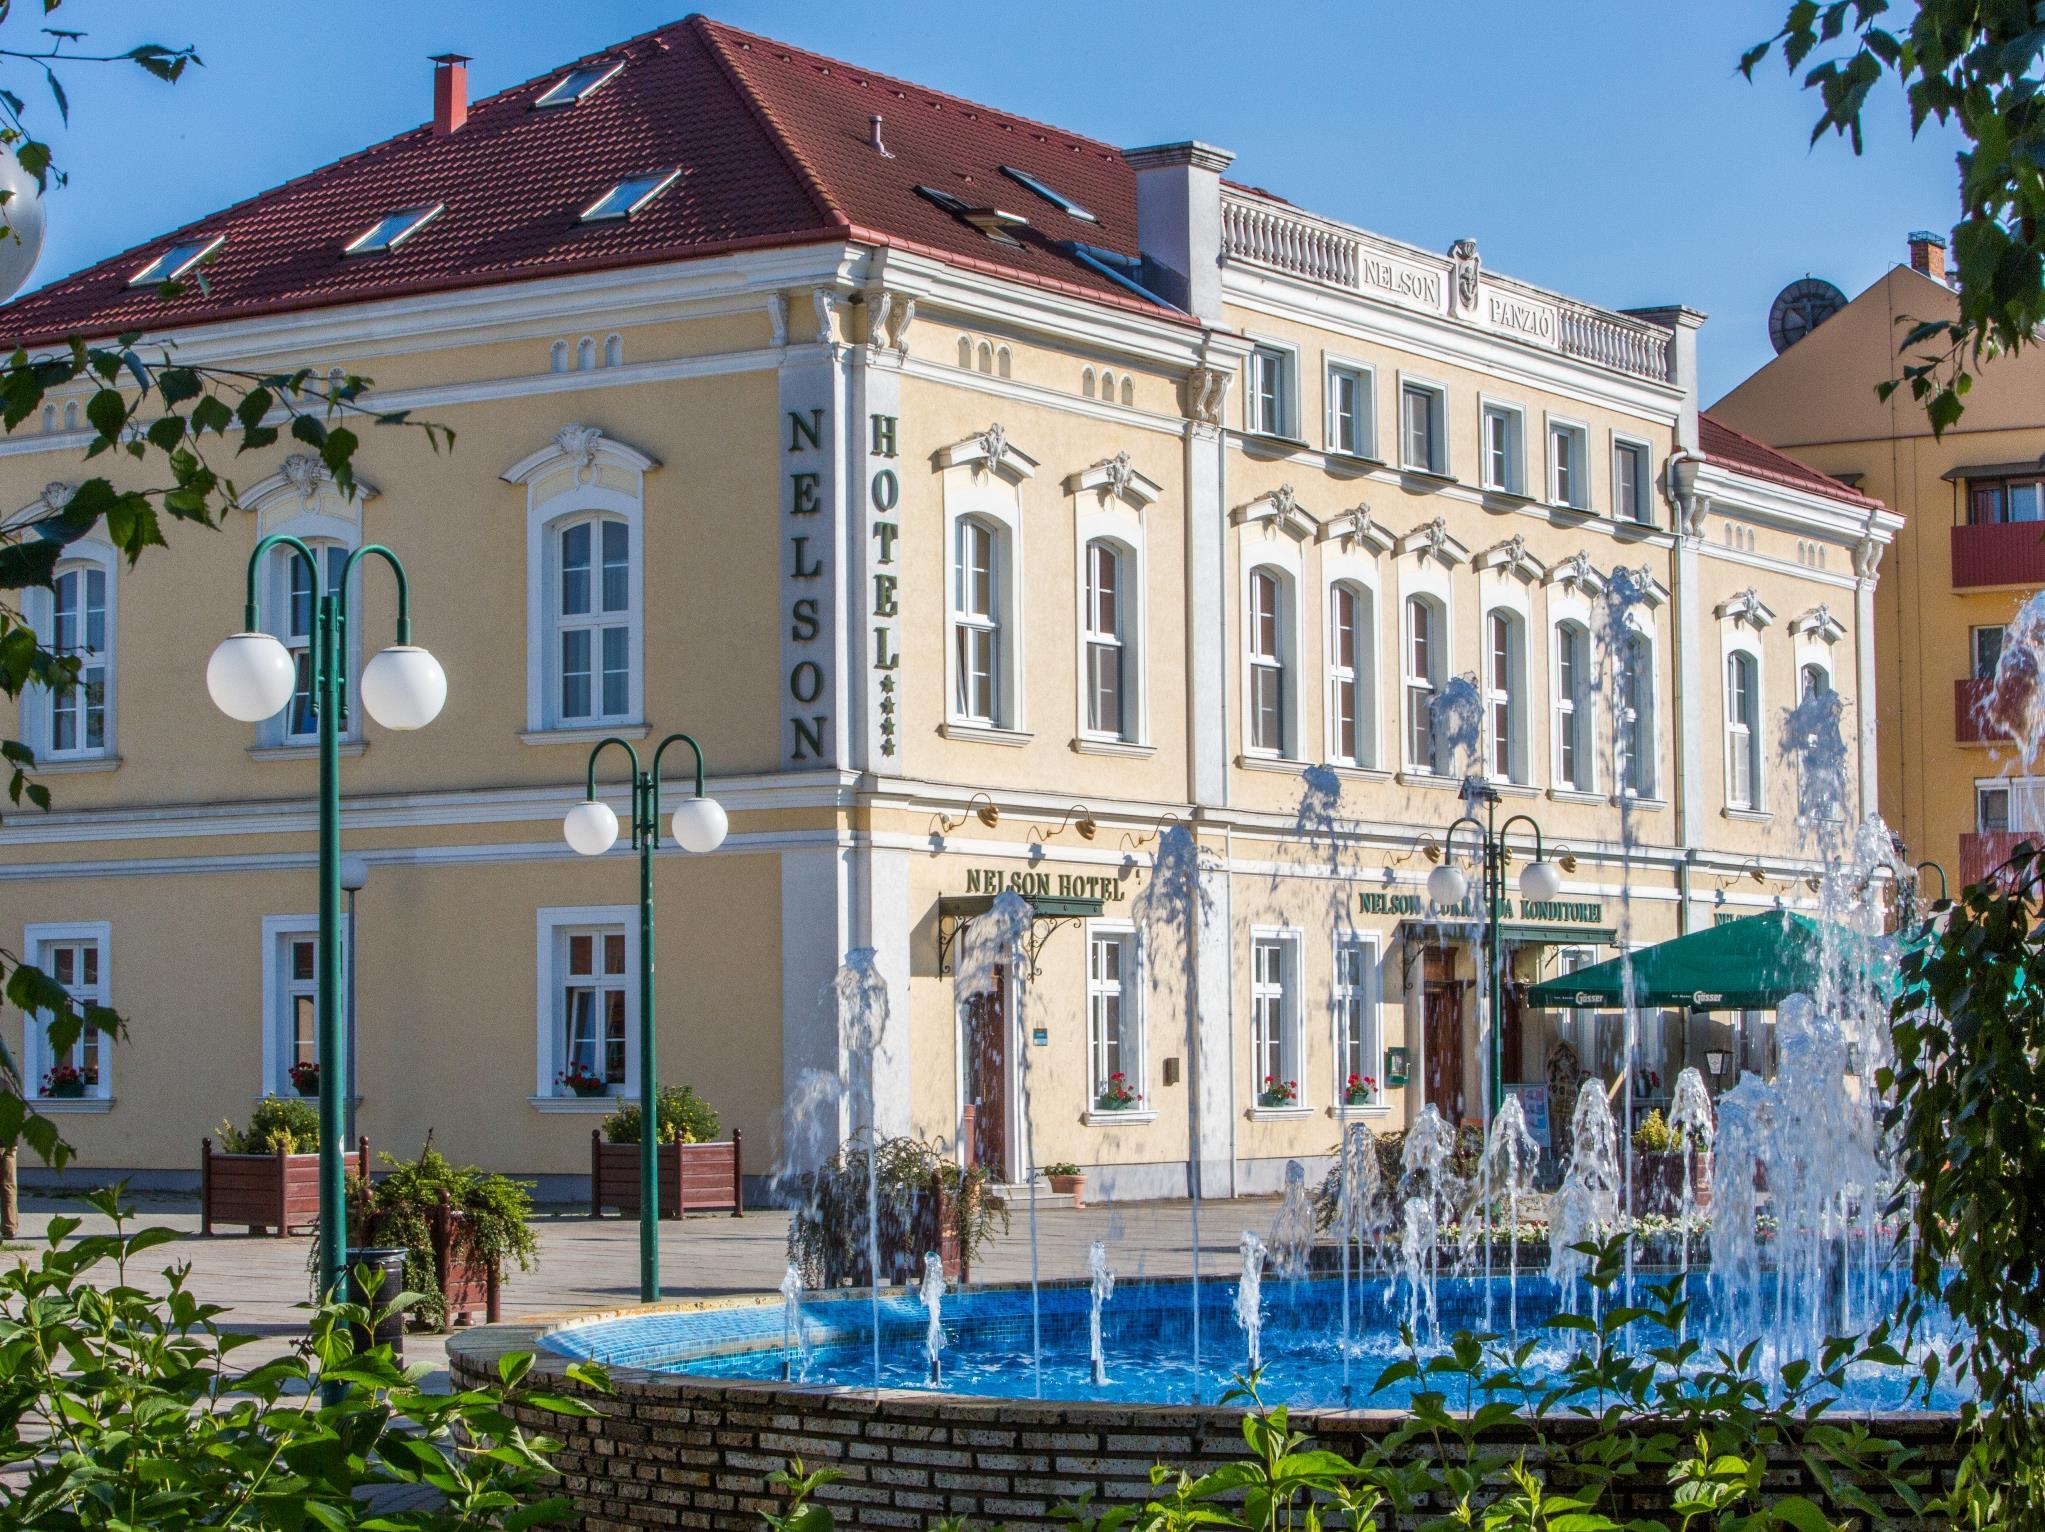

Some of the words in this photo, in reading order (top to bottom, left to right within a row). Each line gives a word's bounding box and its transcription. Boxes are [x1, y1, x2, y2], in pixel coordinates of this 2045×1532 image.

[1364, 258, 1435, 303] NELSON
[1489, 297, 1550, 338] PANZIÓ
[870, 413, 899, 671] HOTEL
[788, 408, 826, 760] NELSON
[965, 868, 1050, 897] NELSON
[1058, 874, 1125, 902] HOTEL
[1359, 892, 1421, 915] NELSON
[1519, 899, 1602, 923] KONDITOREI
[1693, 990, 1722, 1005] Gösser
